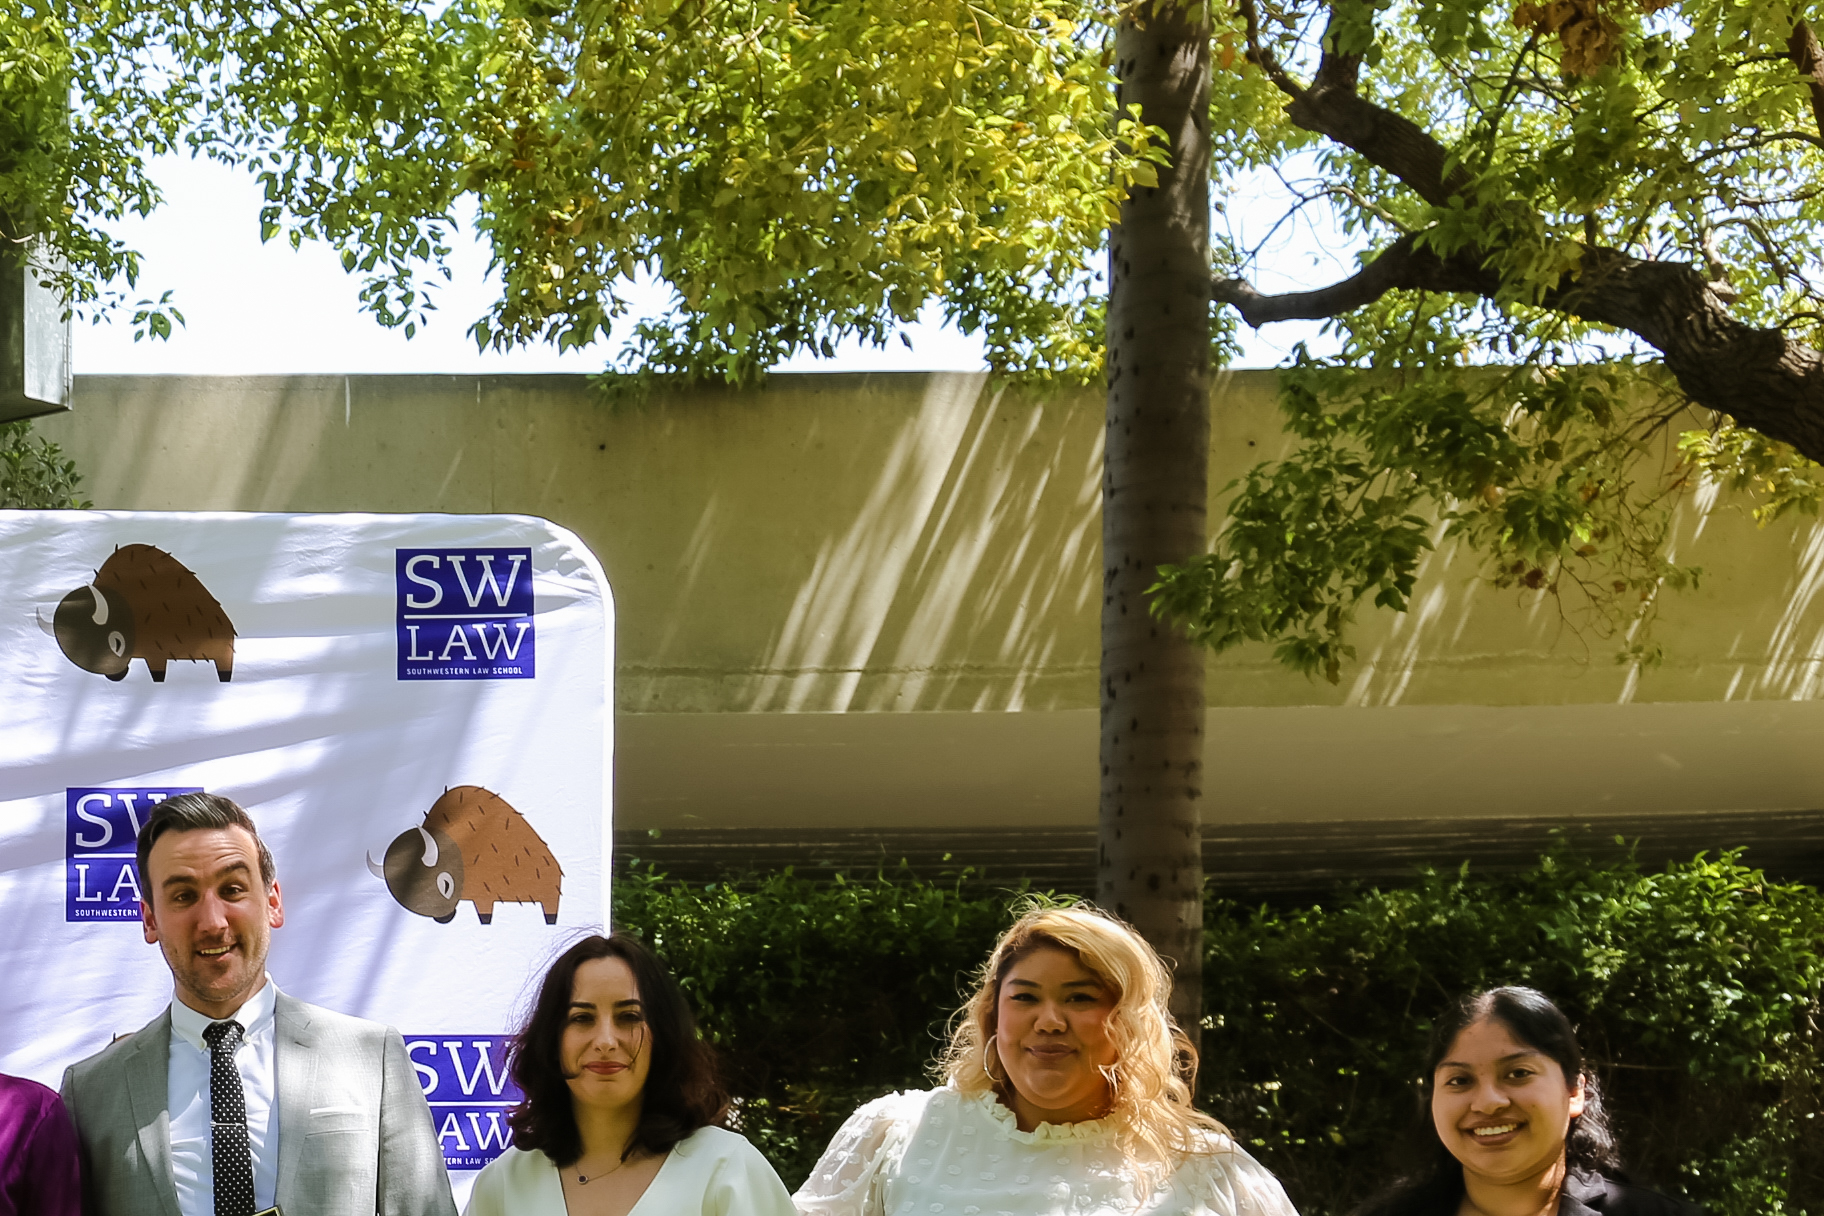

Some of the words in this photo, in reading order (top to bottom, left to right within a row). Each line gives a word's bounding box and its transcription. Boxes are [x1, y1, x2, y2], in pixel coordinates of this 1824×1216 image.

[406, 555, 526, 608] SW
[406, 623, 530, 660] LAW
[75, 864, 141, 901] LA
[406, 1041, 517, 1095] SW
[438, 1113, 515, 1150] AW
